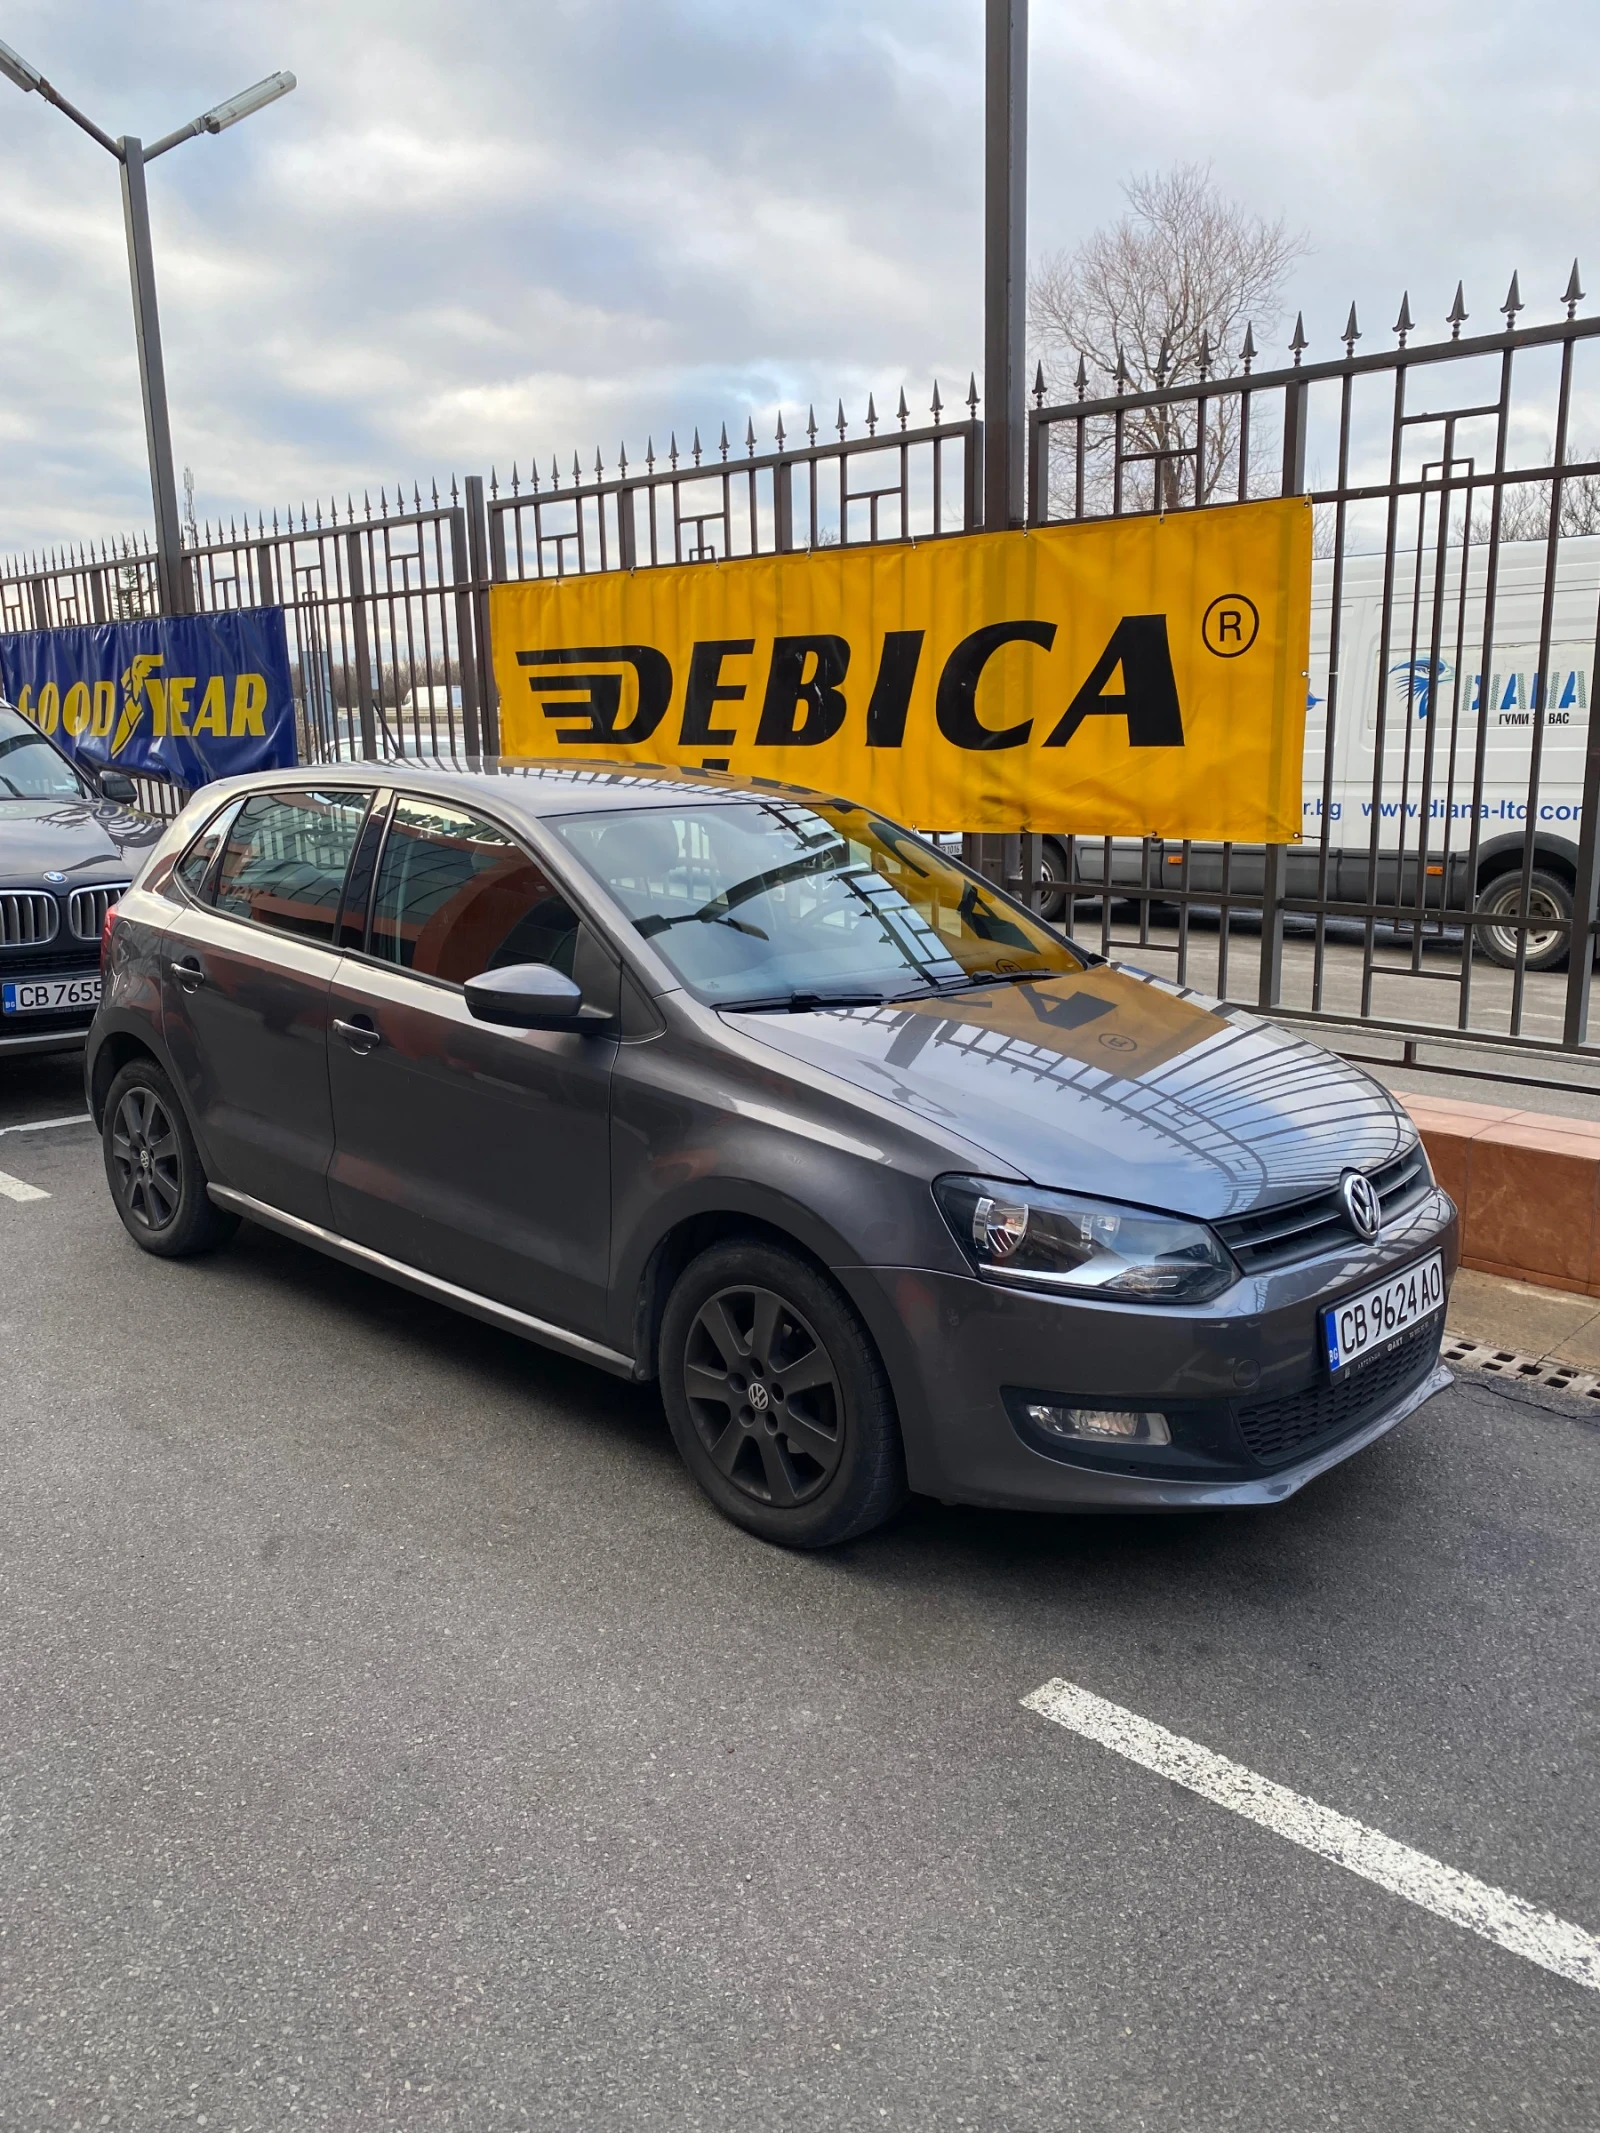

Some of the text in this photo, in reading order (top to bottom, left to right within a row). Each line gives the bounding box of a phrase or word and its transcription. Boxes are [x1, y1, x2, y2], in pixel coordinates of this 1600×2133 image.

[1499, 713, 1529, 725] ГУМИ
[1548, 712, 1570, 724] ВАС
[1361, 799, 1583, 821] www.diana-ltdco
[5, 1001, 15, 1009] BG
[20, 986, 49, 1007] CB
[1371, 1274, 1417, 1338] 9624
[1328, 1348, 1339, 1363] BG
